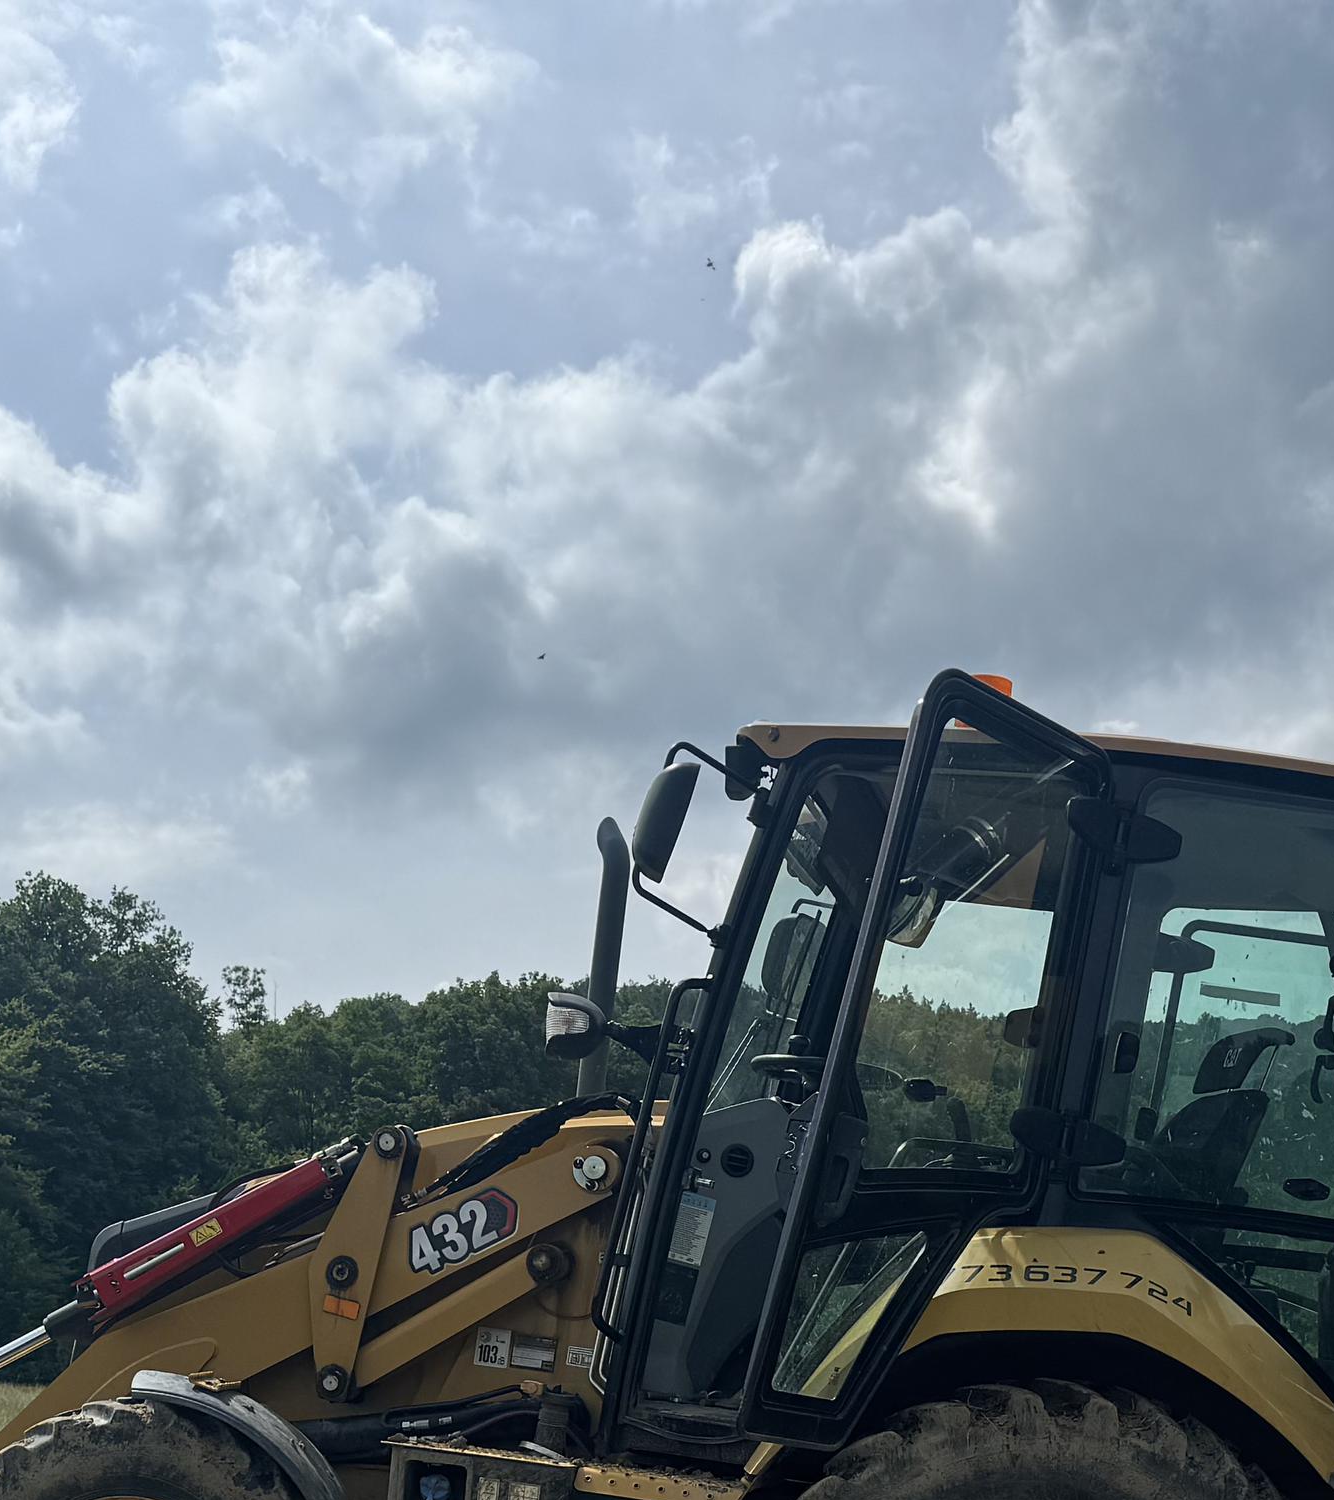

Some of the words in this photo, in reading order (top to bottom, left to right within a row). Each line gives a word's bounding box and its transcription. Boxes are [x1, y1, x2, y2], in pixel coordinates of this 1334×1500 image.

[411, 1199, 499, 1271] 432
[942, 1264, 1013, 1285] 73
[1023, 1265, 1107, 1285] 637
[1119, 1272, 1194, 1317] 724
[478, 1343, 499, 1364] 103
